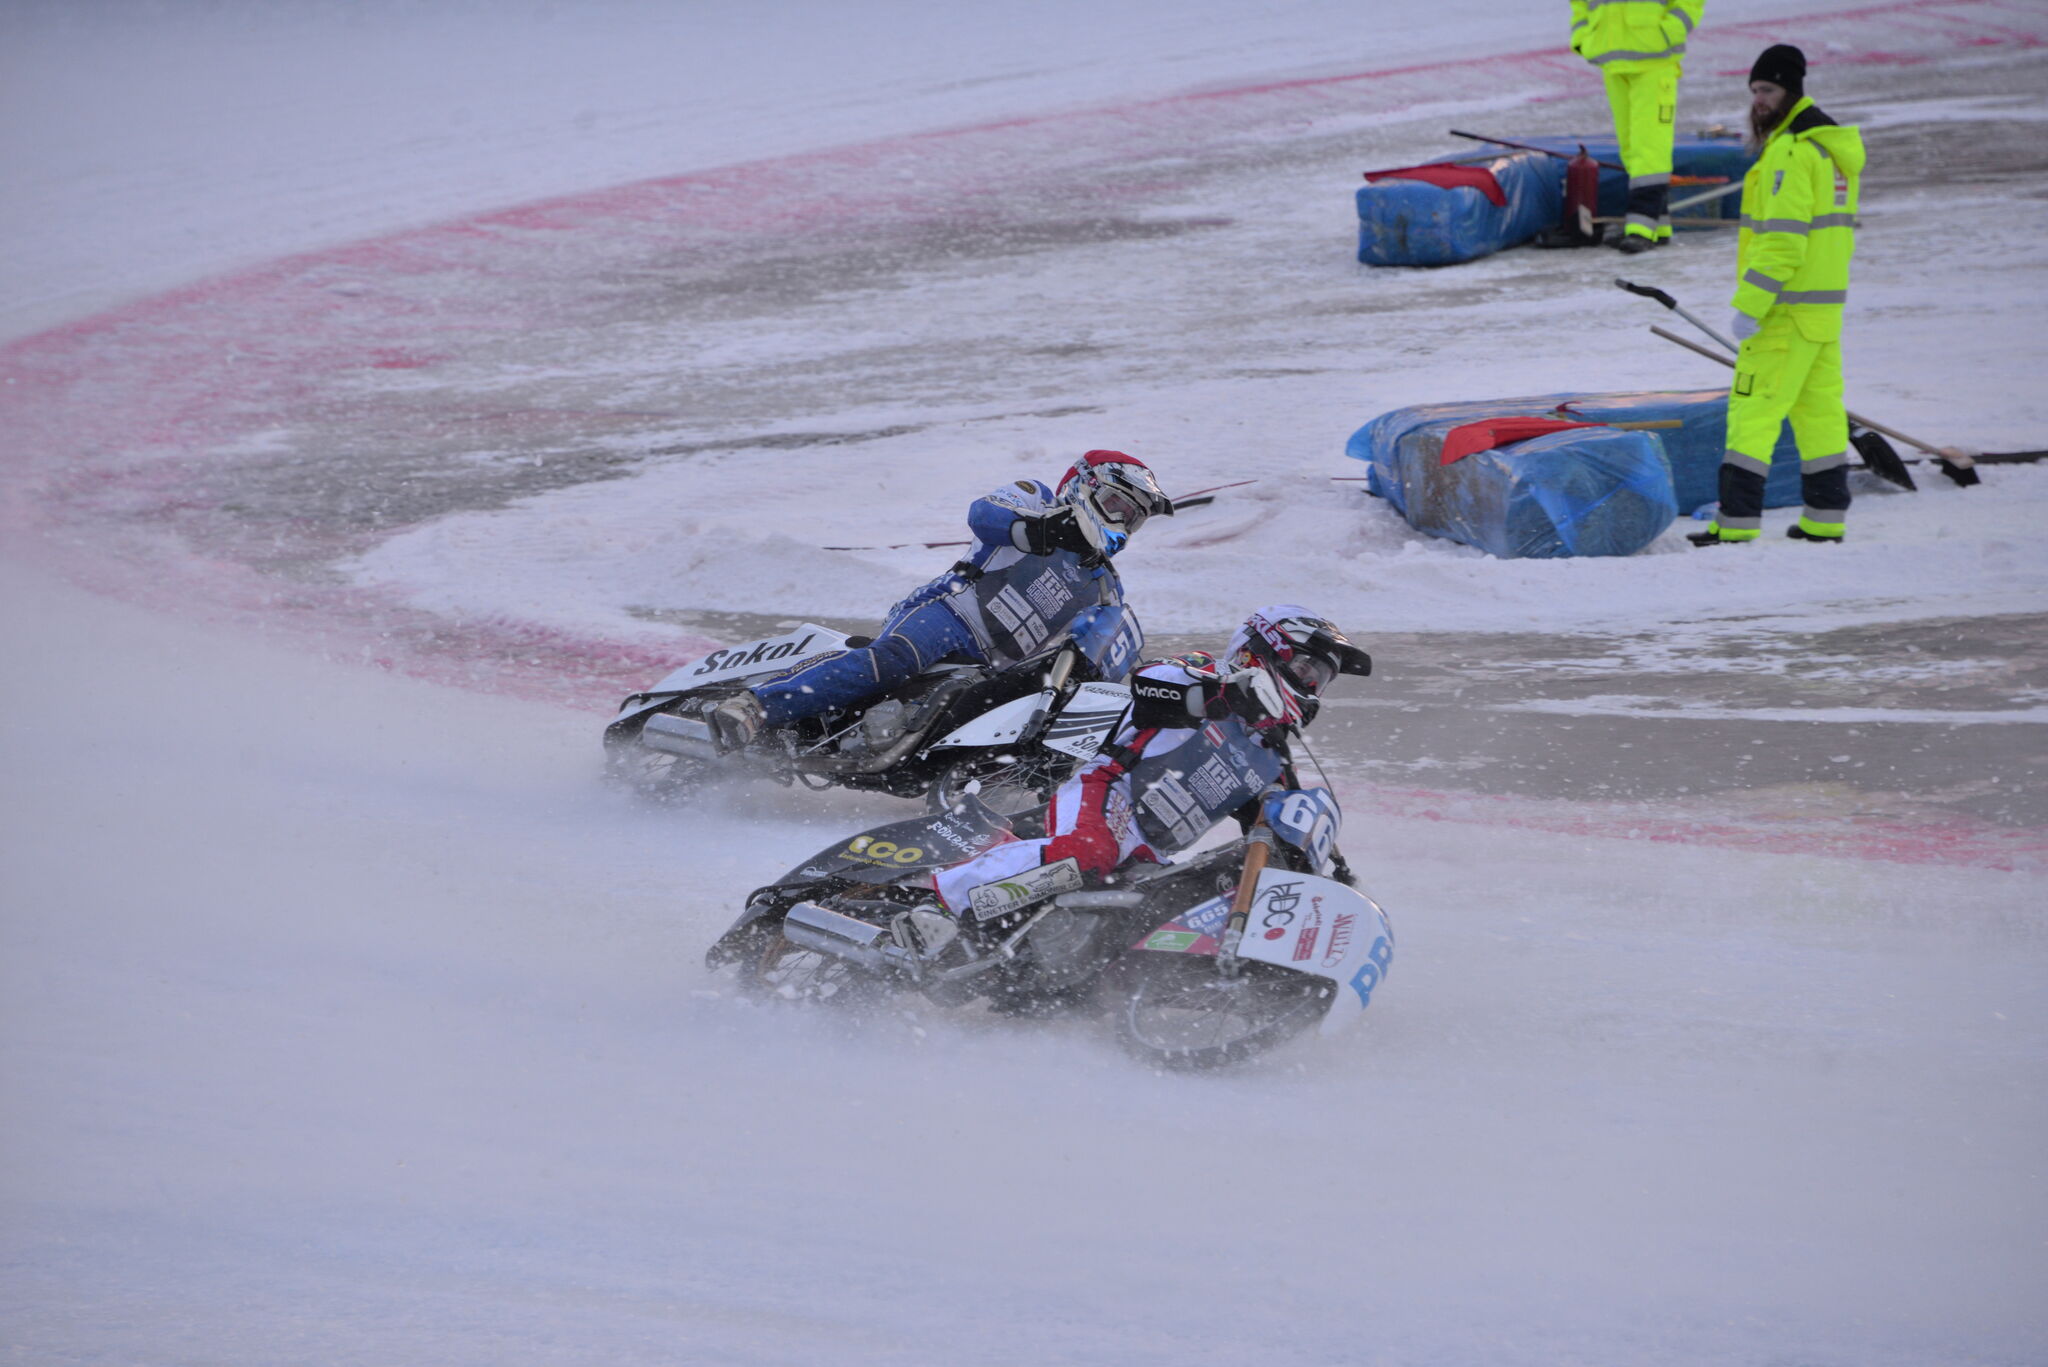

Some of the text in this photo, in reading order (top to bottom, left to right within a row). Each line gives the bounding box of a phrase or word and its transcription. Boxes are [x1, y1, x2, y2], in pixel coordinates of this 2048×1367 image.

[1038, 568, 1071, 606] ICE
[1134, 683, 1182, 700] WACO
[1203, 755, 1240, 796] ICE
[1243, 768, 1265, 794] 665
[1187, 903, 1229, 929] 665
